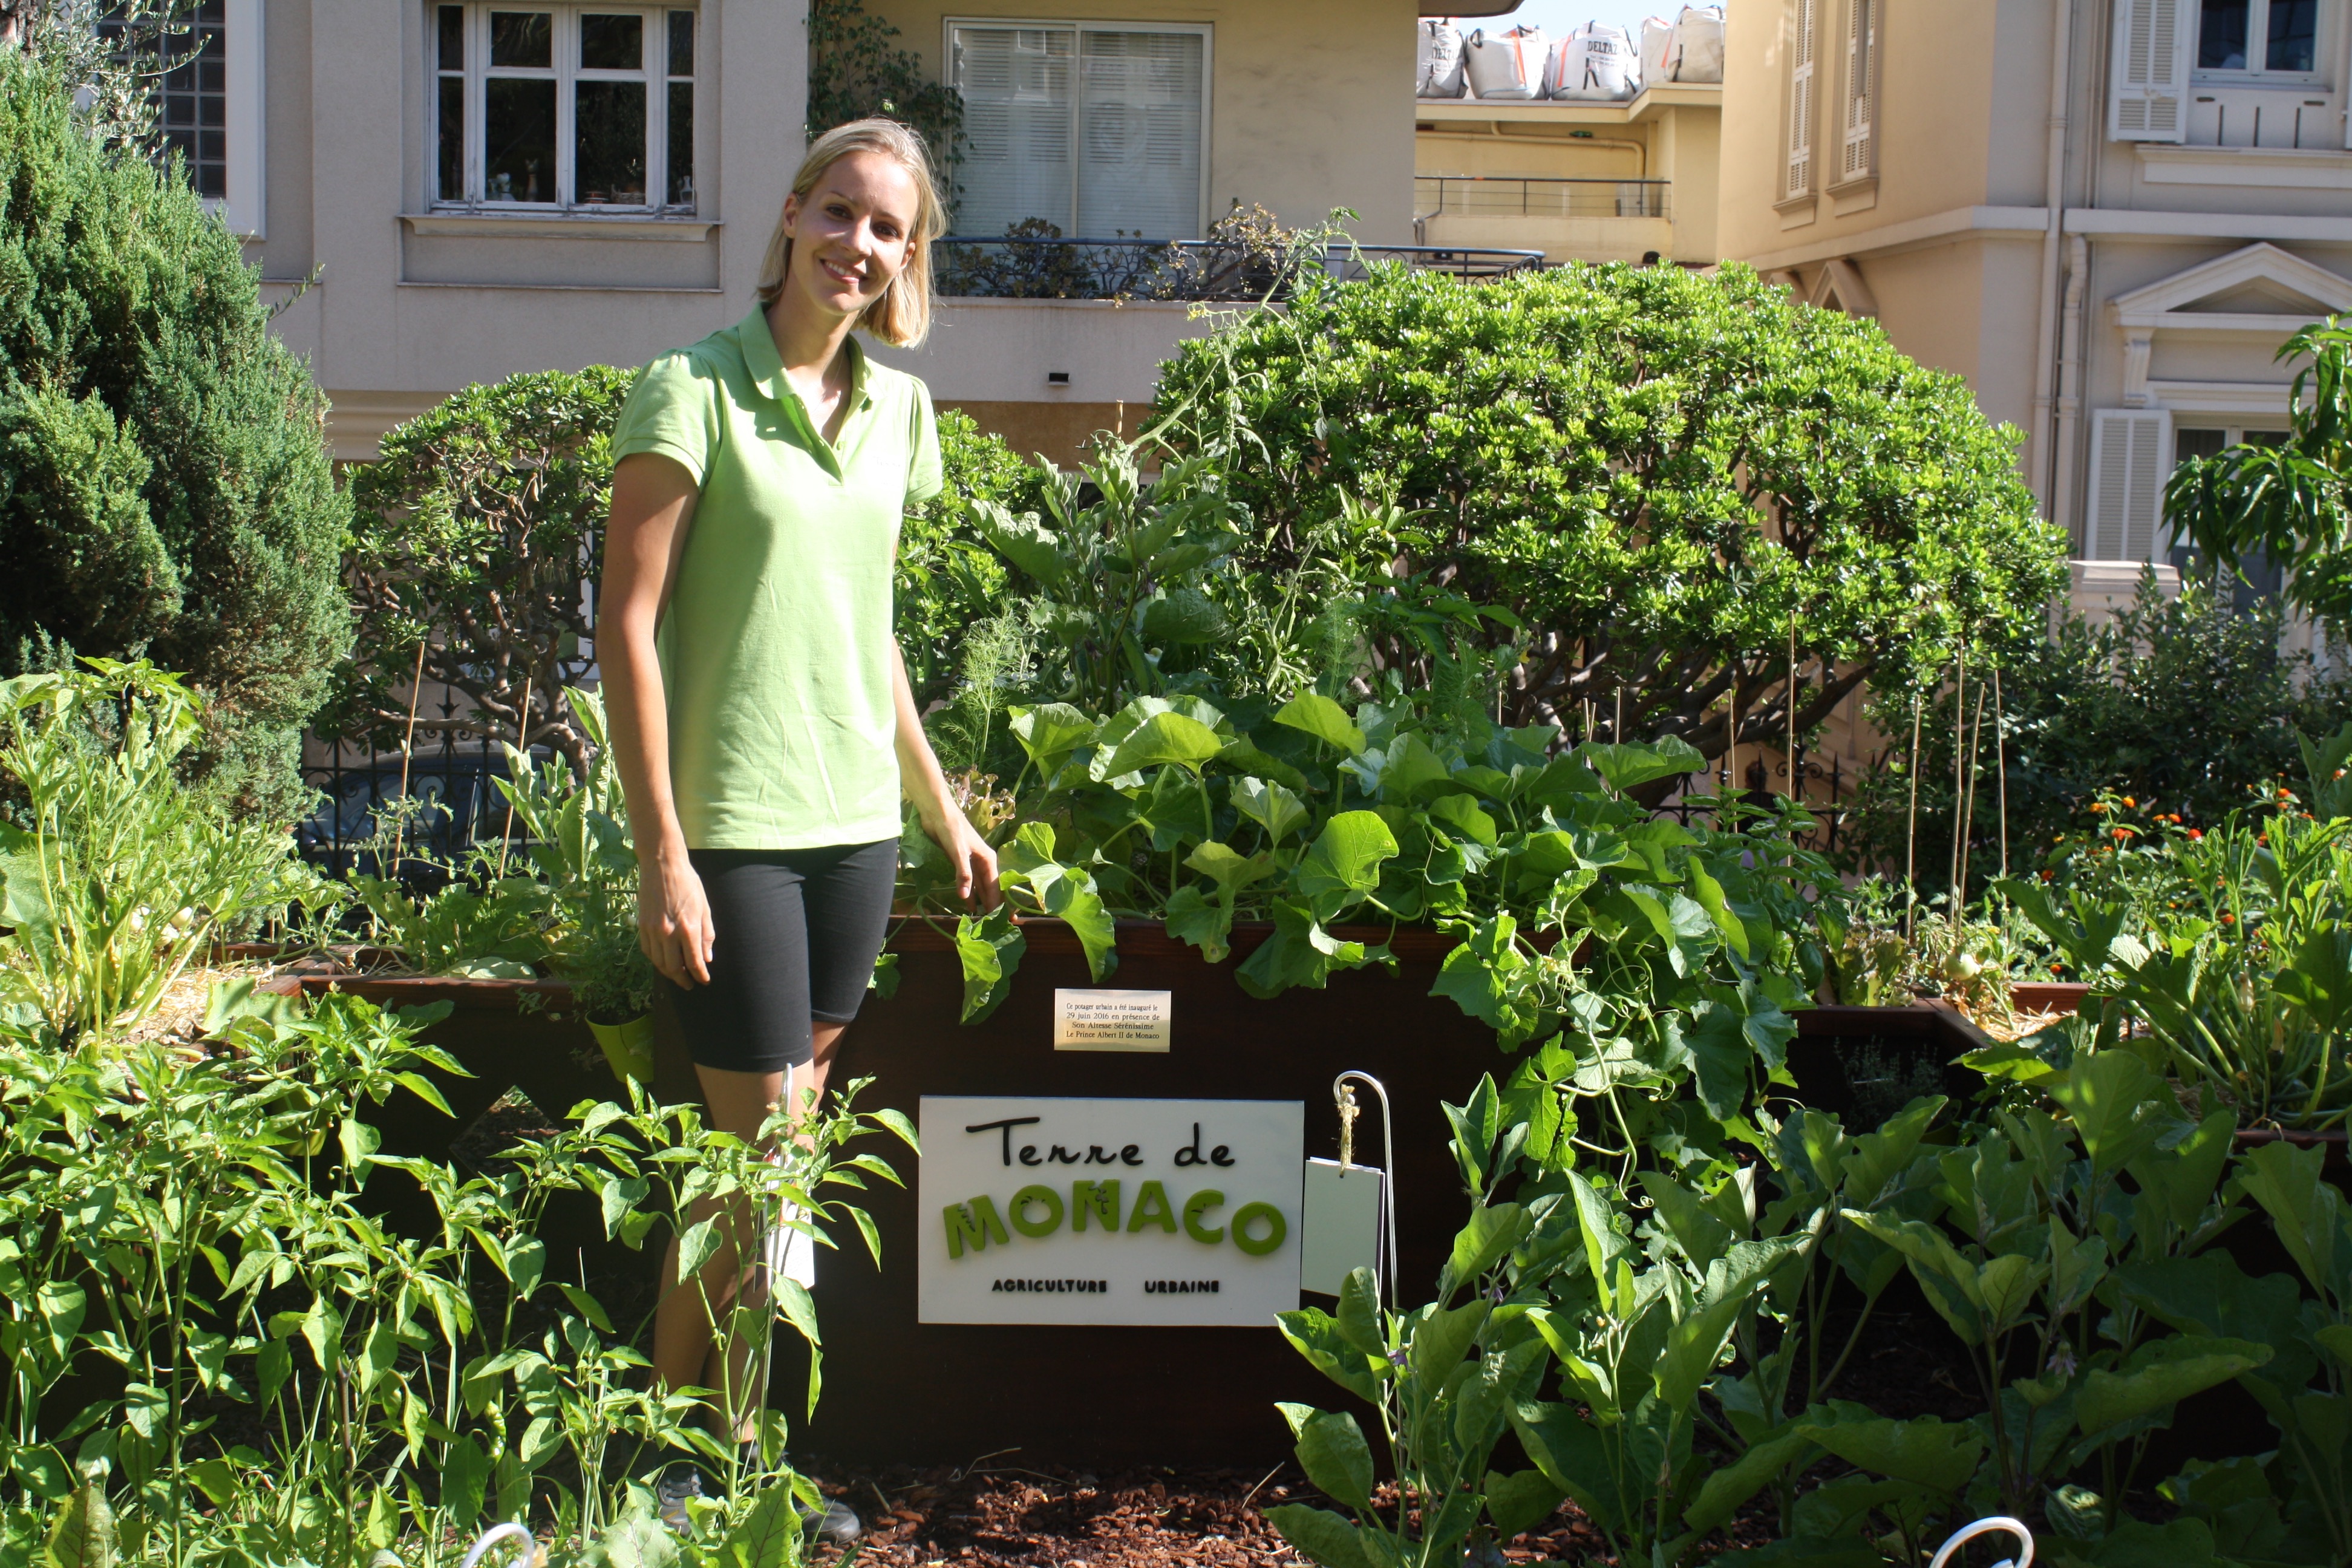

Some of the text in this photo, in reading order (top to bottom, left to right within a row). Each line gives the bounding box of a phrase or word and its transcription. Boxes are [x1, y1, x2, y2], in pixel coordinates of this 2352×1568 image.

[1122, 1013, 1149, 1022] présence
[965, 1116, 1236, 1167] Terre de
[942, 1179, 1287, 1260] MONACO
[991, 1278, 1220, 1293] AGRICULTURE URBAINE
